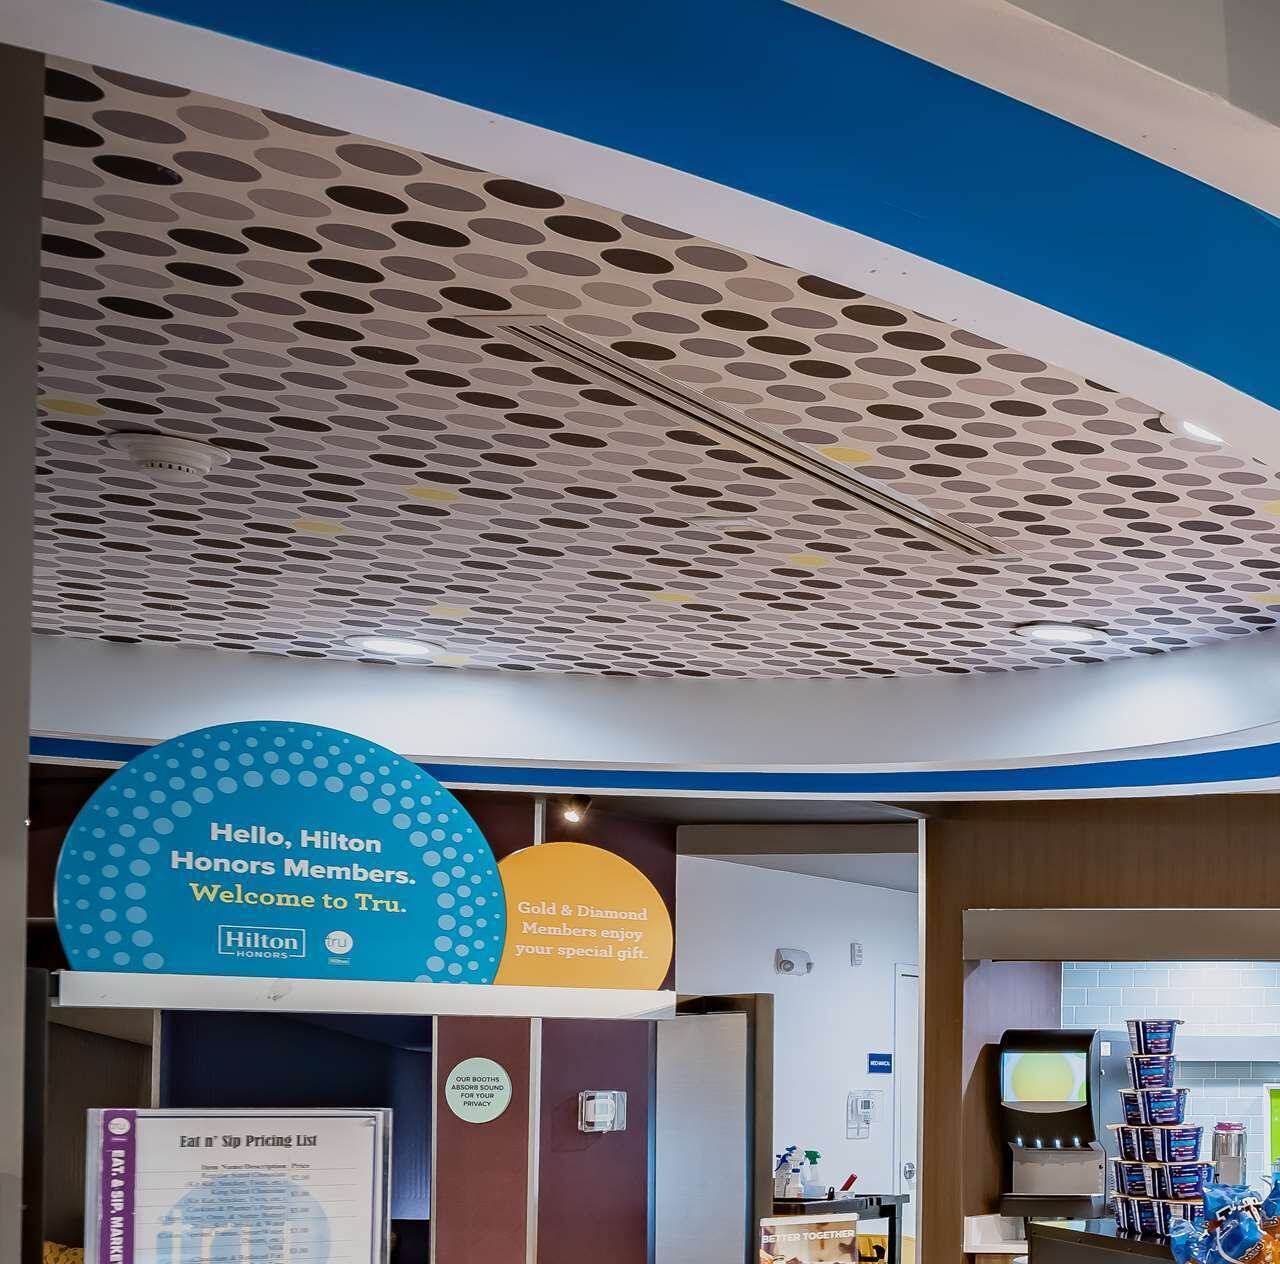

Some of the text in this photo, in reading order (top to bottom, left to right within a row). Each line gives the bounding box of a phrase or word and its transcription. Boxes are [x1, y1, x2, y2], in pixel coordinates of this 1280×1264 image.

[211, 823, 381, 853] Hello, Hilton
[171, 850, 416, 885] Honors Members.
[189, 883, 406, 913] Welcome to Tru.
[518, 902, 648, 920] Gold & Diamond
[226, 931, 298, 950] Hilton
[522, 922, 642, 942] Members enjoy
[236, 950, 288, 959] HONORS
[516, 944, 648, 961] your special gift.
[180, 1135, 201, 1148] Eat
[222, 1135, 241, 1148] Sip
[245, 1134, 292, 1148] Pricing
[296, 1135, 317, 1146] List
[762, 1229, 855, 1243] BETTER TOGETHER
